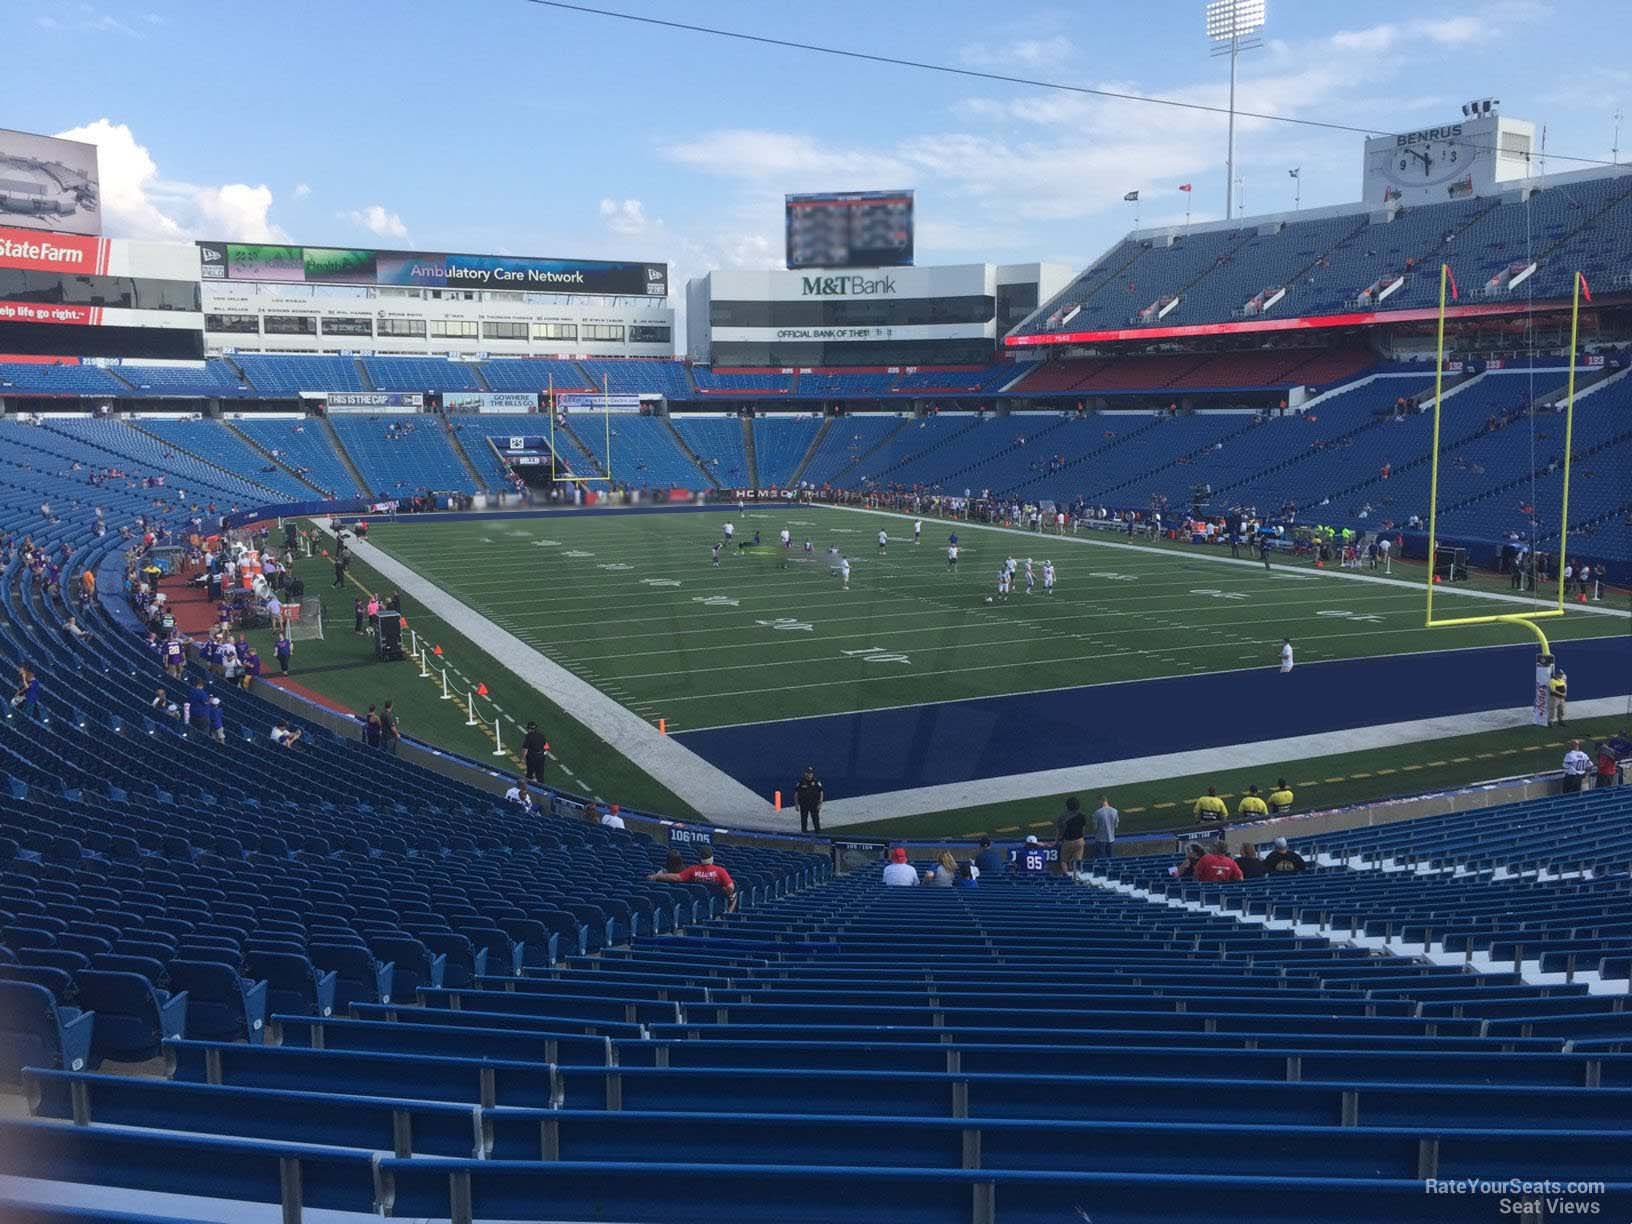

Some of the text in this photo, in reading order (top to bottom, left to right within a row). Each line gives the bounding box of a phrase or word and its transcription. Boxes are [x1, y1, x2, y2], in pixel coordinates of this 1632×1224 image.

[1396, 124, 1462, 147] BENRUS
[1451, 151, 1457, 162] 3
[1400, 160, 1407, 171] 9
[410, 264, 584, 284] Ambulatory Care Network
[801, 274, 896, 295] M&T Bank
[17, 306, 35, 317] life
[36, 309, 49, 319] go
[777, 330, 811, 338] OFFICIAL
[813, 330, 835, 338] BANK
[836, 329, 847, 338] OF
[328, 394, 346, 405] THIS
[347, 394, 356, 405] IS
[356, 394, 371, 405] THE
[504, 400, 522, 408] BILLS
[671, 829, 711, 844] 106 105
[1026, 855, 1042, 870] 85
